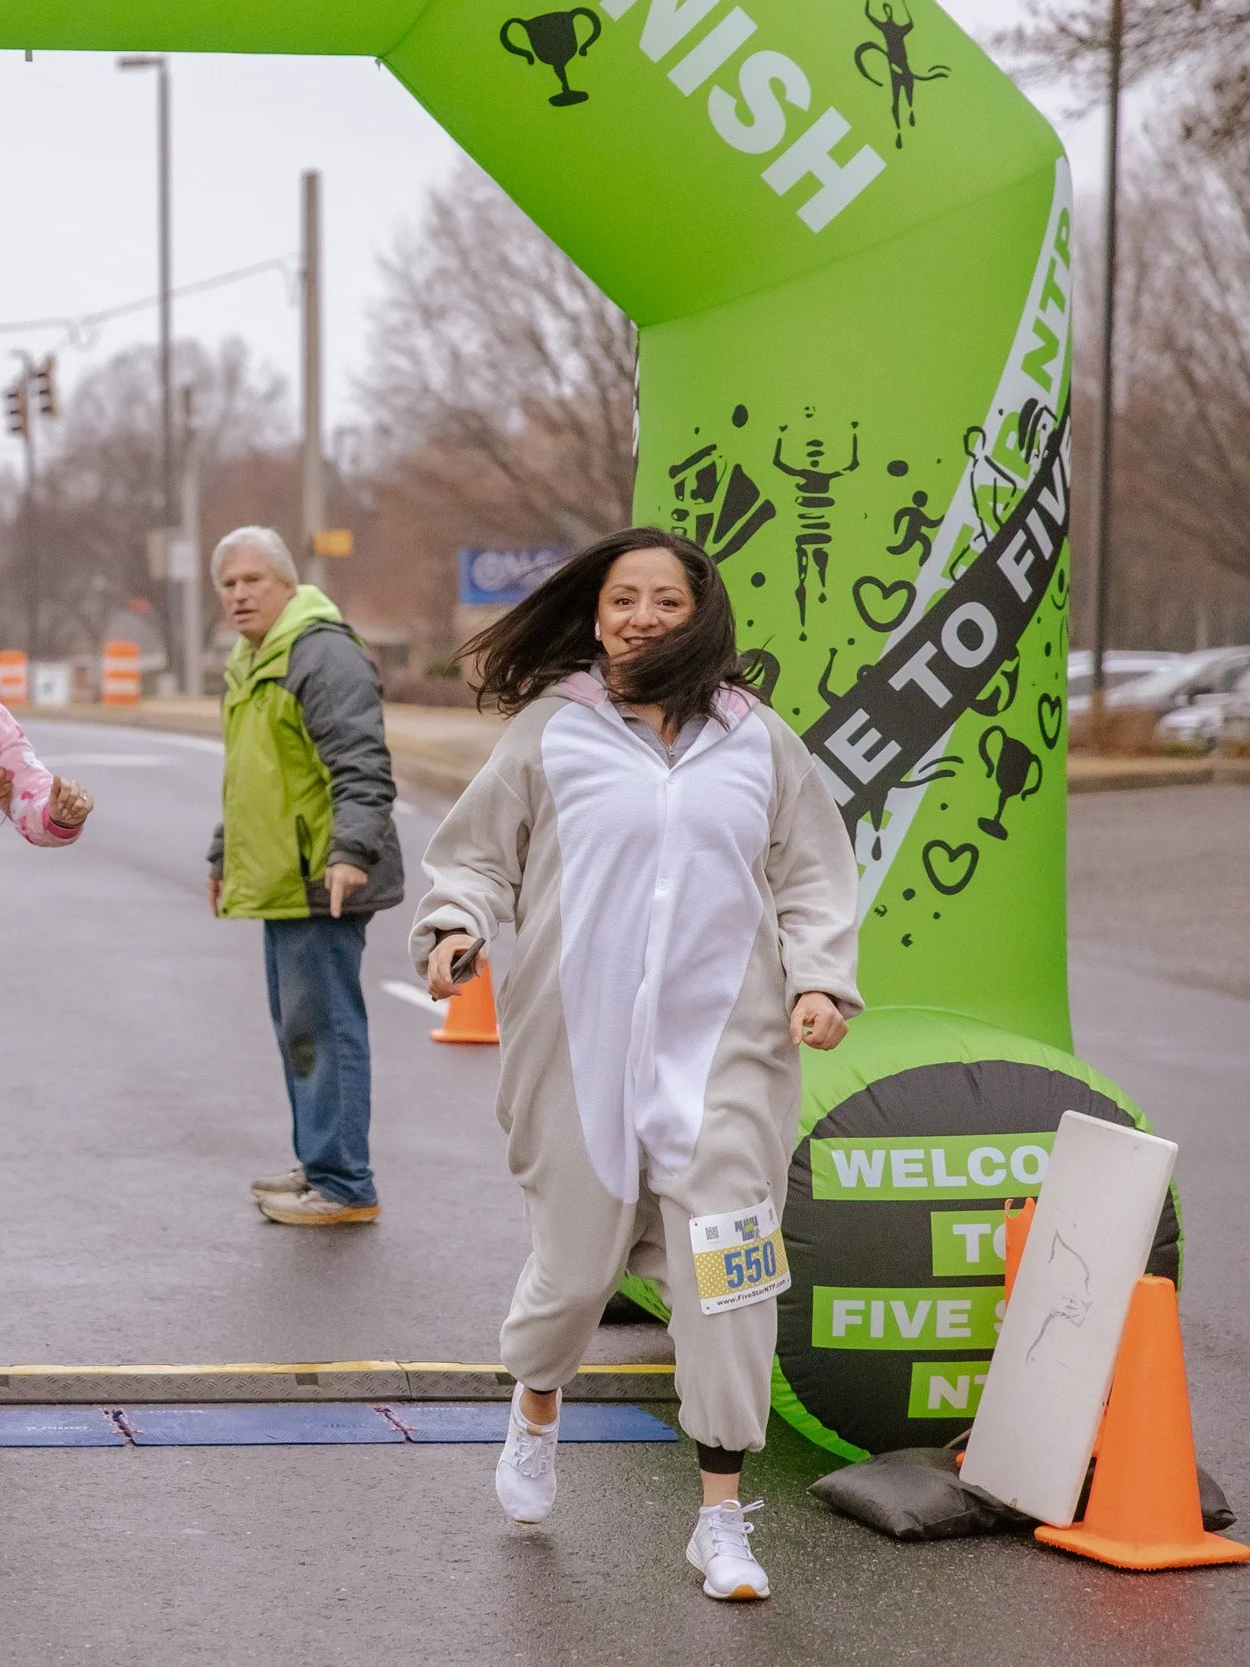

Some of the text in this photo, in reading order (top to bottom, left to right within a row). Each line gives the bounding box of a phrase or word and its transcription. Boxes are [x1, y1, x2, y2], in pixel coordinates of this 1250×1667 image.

[888, 601, 998, 708] TO
[723, 1240, 777, 1289] 550
[716, 1279, 786, 1306] www.FiveStarNTP.com
[830, 1299, 972, 1339] FIVE
